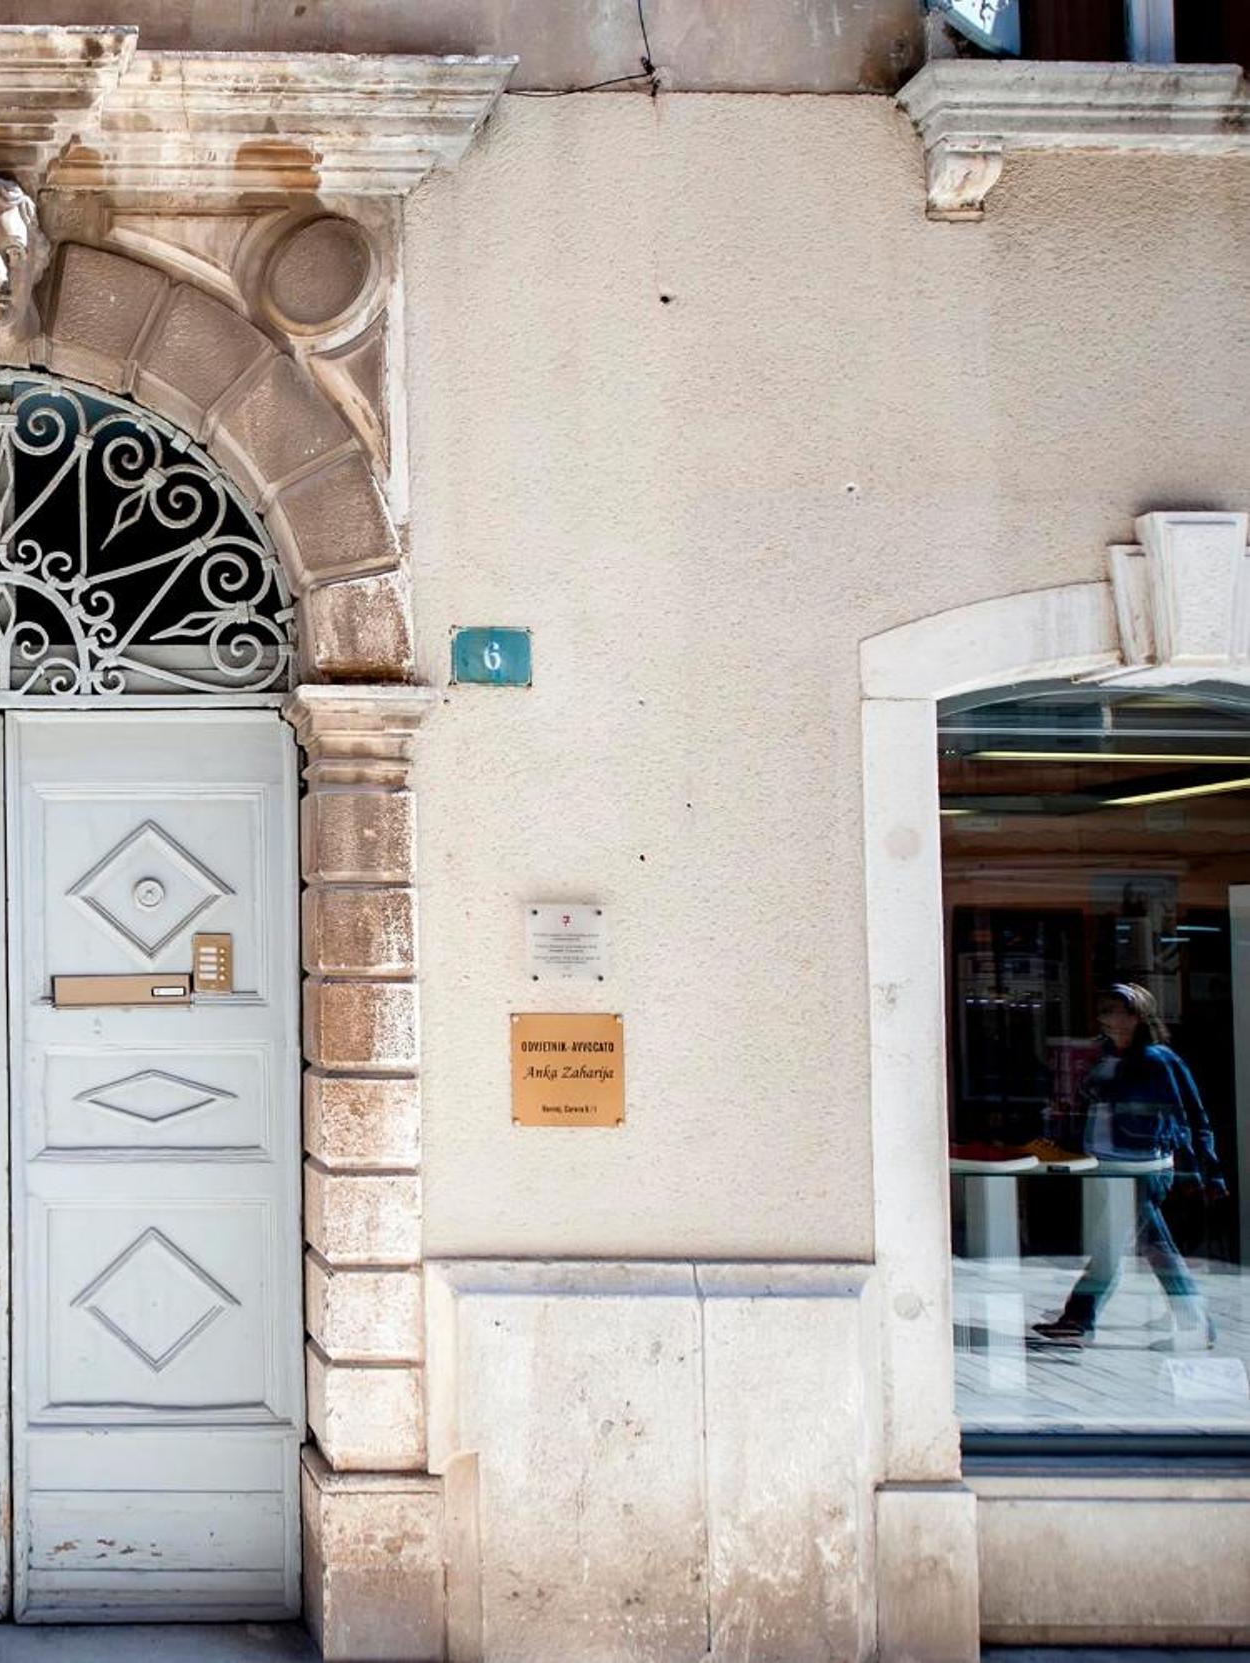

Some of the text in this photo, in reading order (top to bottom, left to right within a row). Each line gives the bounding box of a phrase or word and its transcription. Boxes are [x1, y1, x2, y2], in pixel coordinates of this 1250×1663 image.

[484, 641, 501, 671] 6
[522, 1064, 615, 1084] Anka Zaharija
